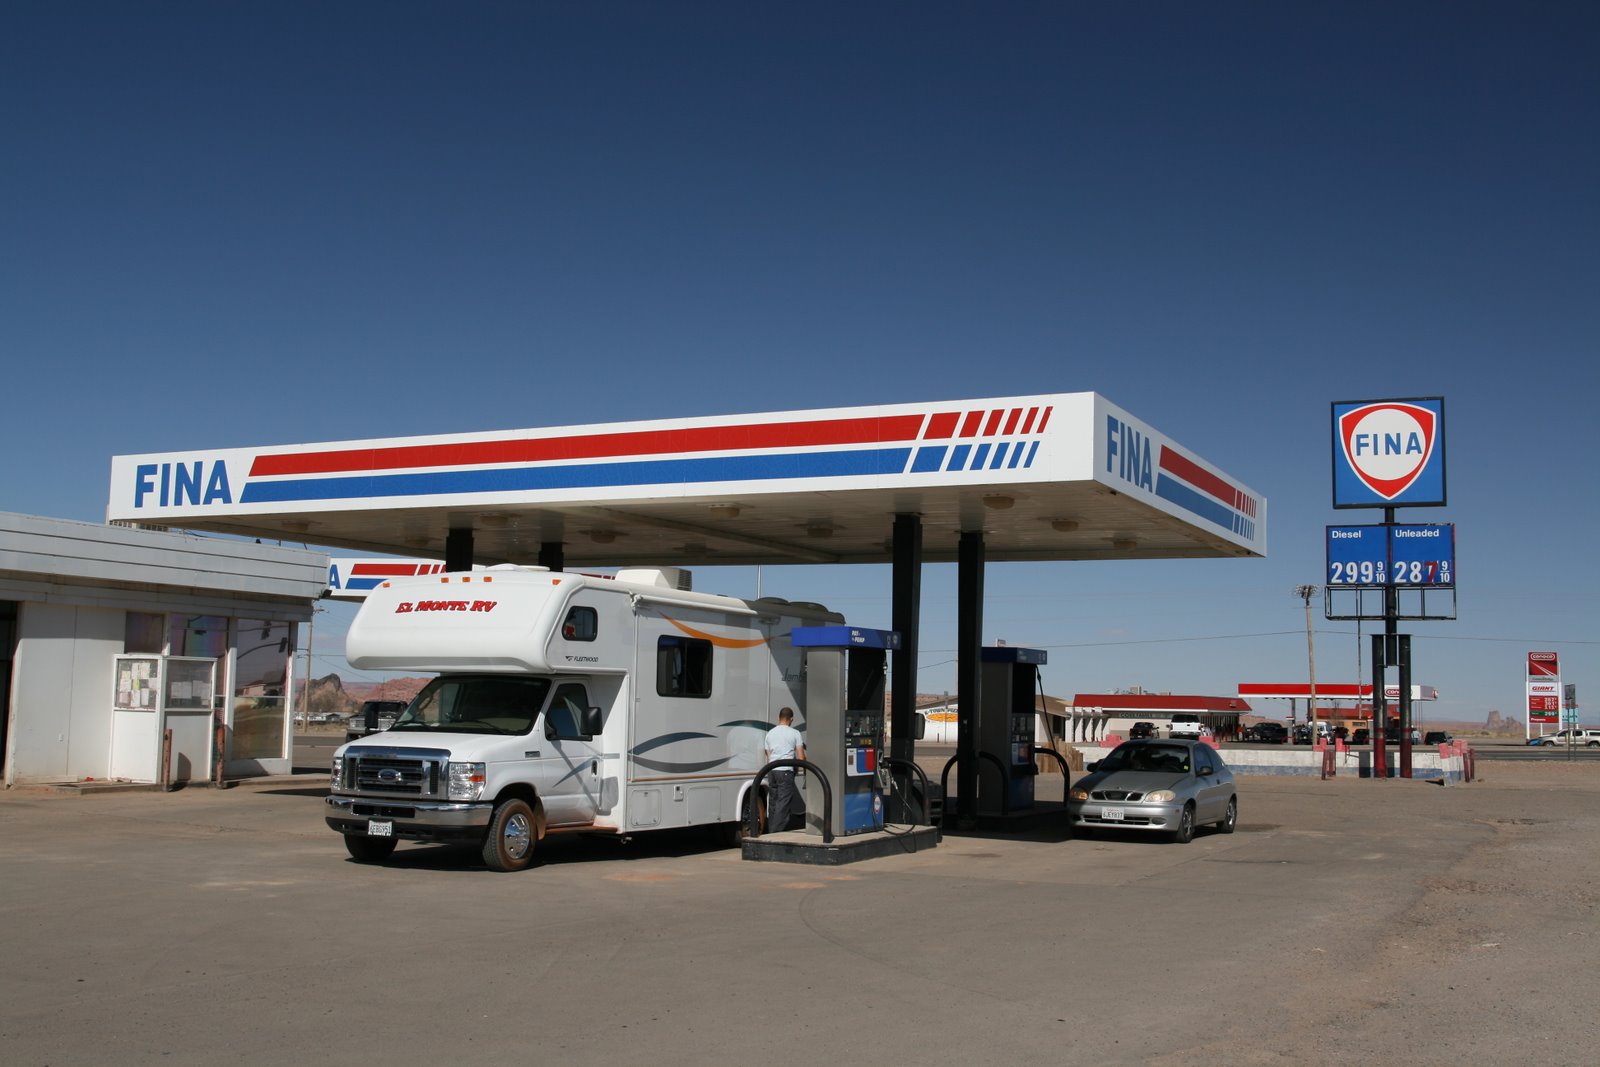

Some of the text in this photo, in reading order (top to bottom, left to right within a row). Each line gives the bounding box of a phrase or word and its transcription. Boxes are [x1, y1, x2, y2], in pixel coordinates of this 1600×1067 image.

[1107, 414, 1153, 493] FINA
[1356, 432, 1422, 456] FINA
[134, 460, 232, 508] FINA
[1332, 530, 1362, 539] Diesel
[1395, 529, 1440, 538] Unleaded
[1331, 562, 1374, 583] 299
[395, 600, 498, 613] EL MONTE RV
